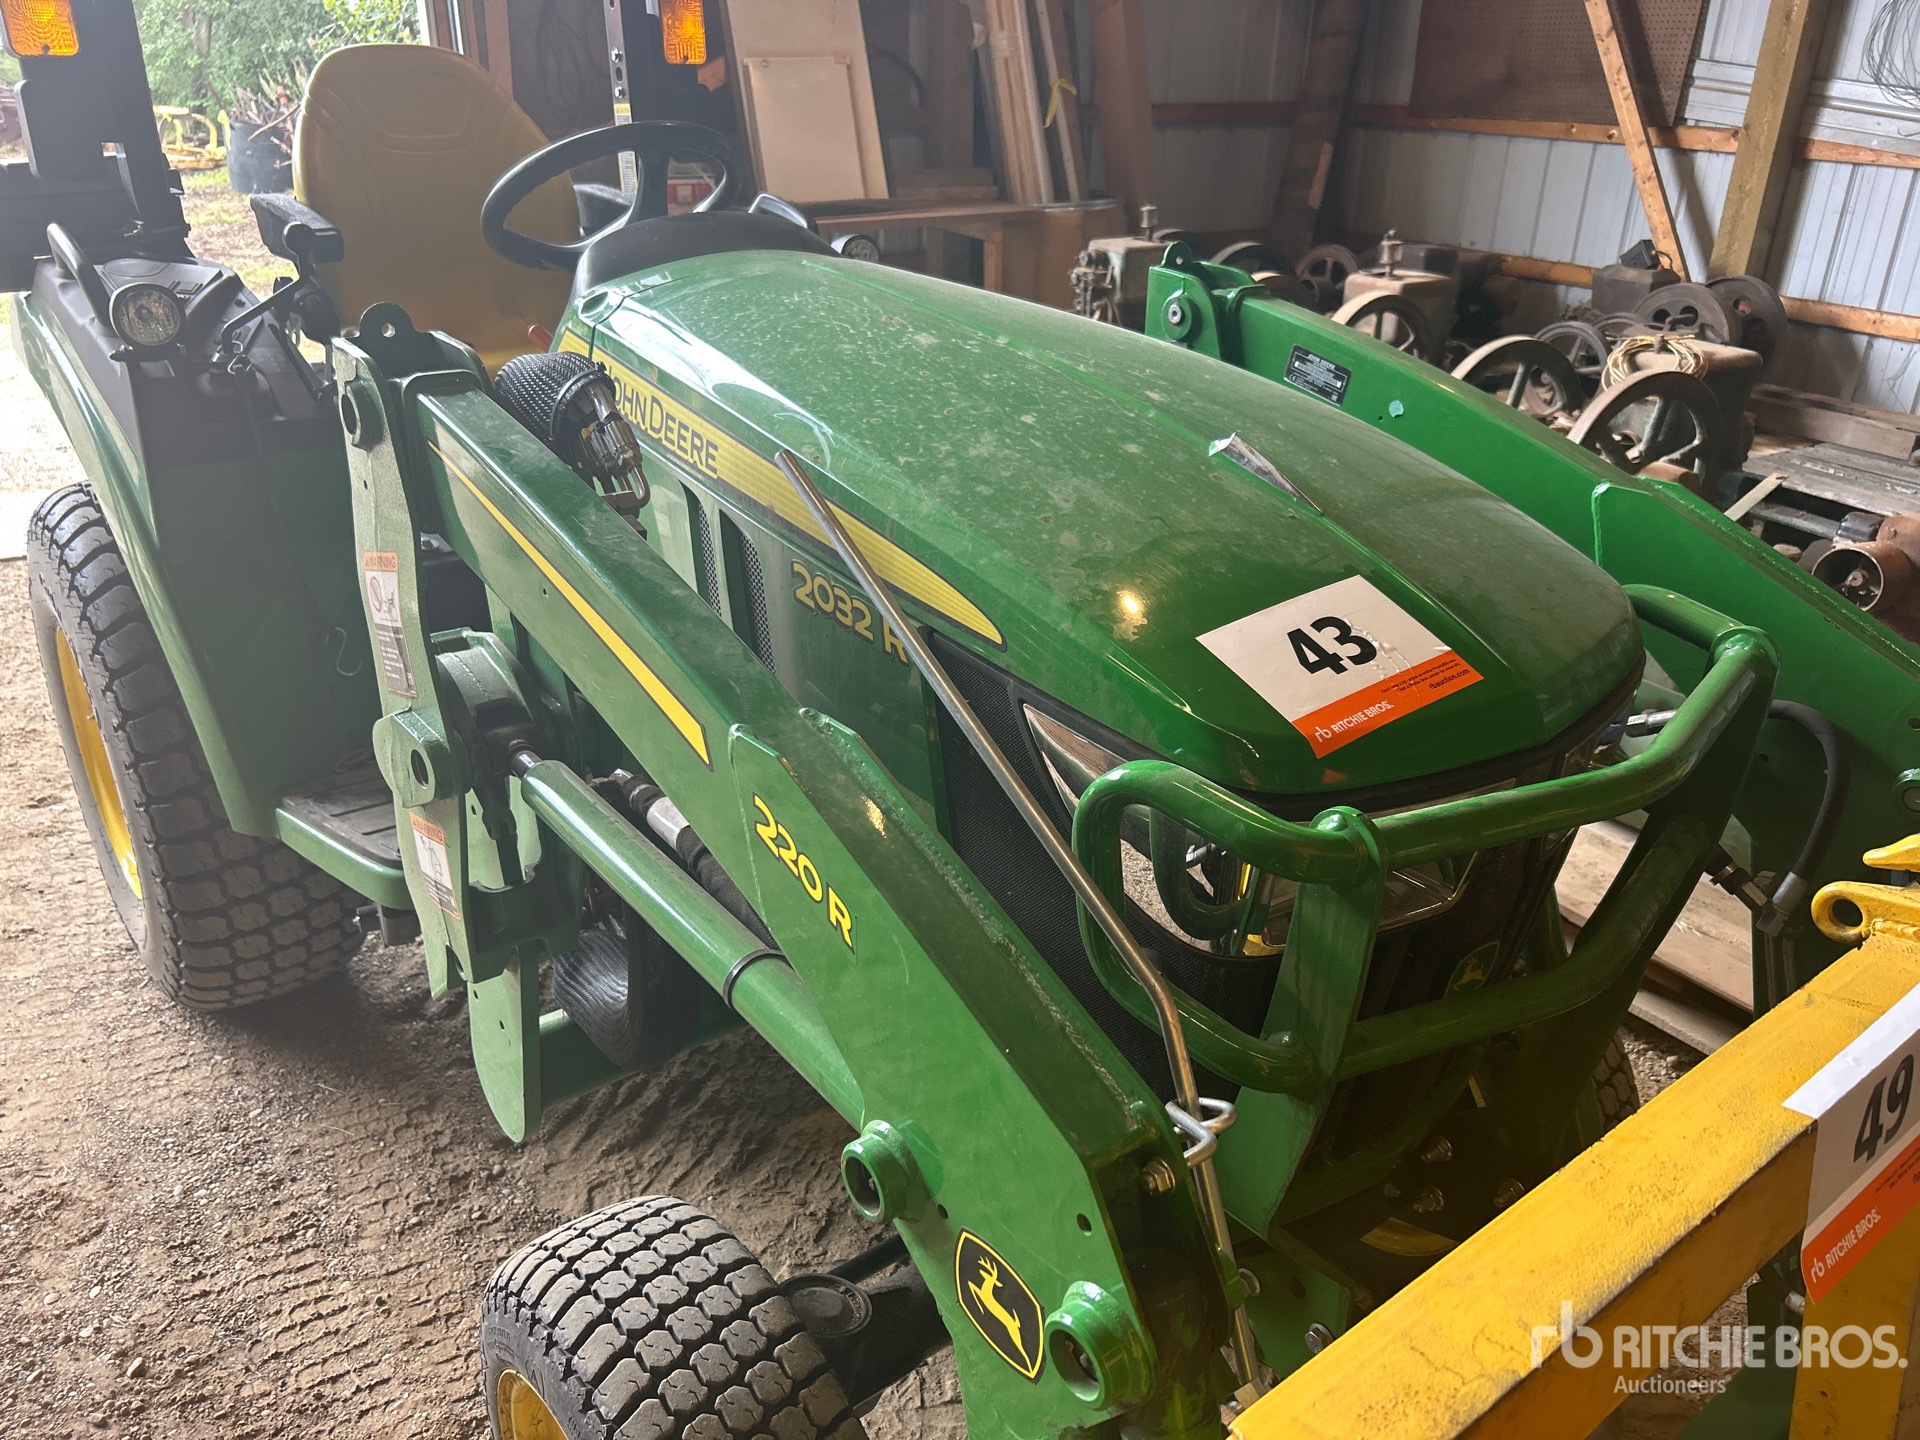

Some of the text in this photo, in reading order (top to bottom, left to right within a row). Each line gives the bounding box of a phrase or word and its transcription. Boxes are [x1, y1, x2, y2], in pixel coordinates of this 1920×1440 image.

[649, 395, 719, 475] DEERE
[792, 560, 874, 642] 2032
[1286, 616, 1378, 675] 43
[1428, 668, 1471, 690] rbauction.com
[1330, 711, 1369, 734] RITCHIE
[1363, 700, 1395, 718] BROS.
[753, 793, 855, 950] 220 R
[1853, 1054, 1915, 1164] 49
[1825, 1229, 1858, 1270] RITCHIE
[1855, 1208, 1882, 1239] BROS.
